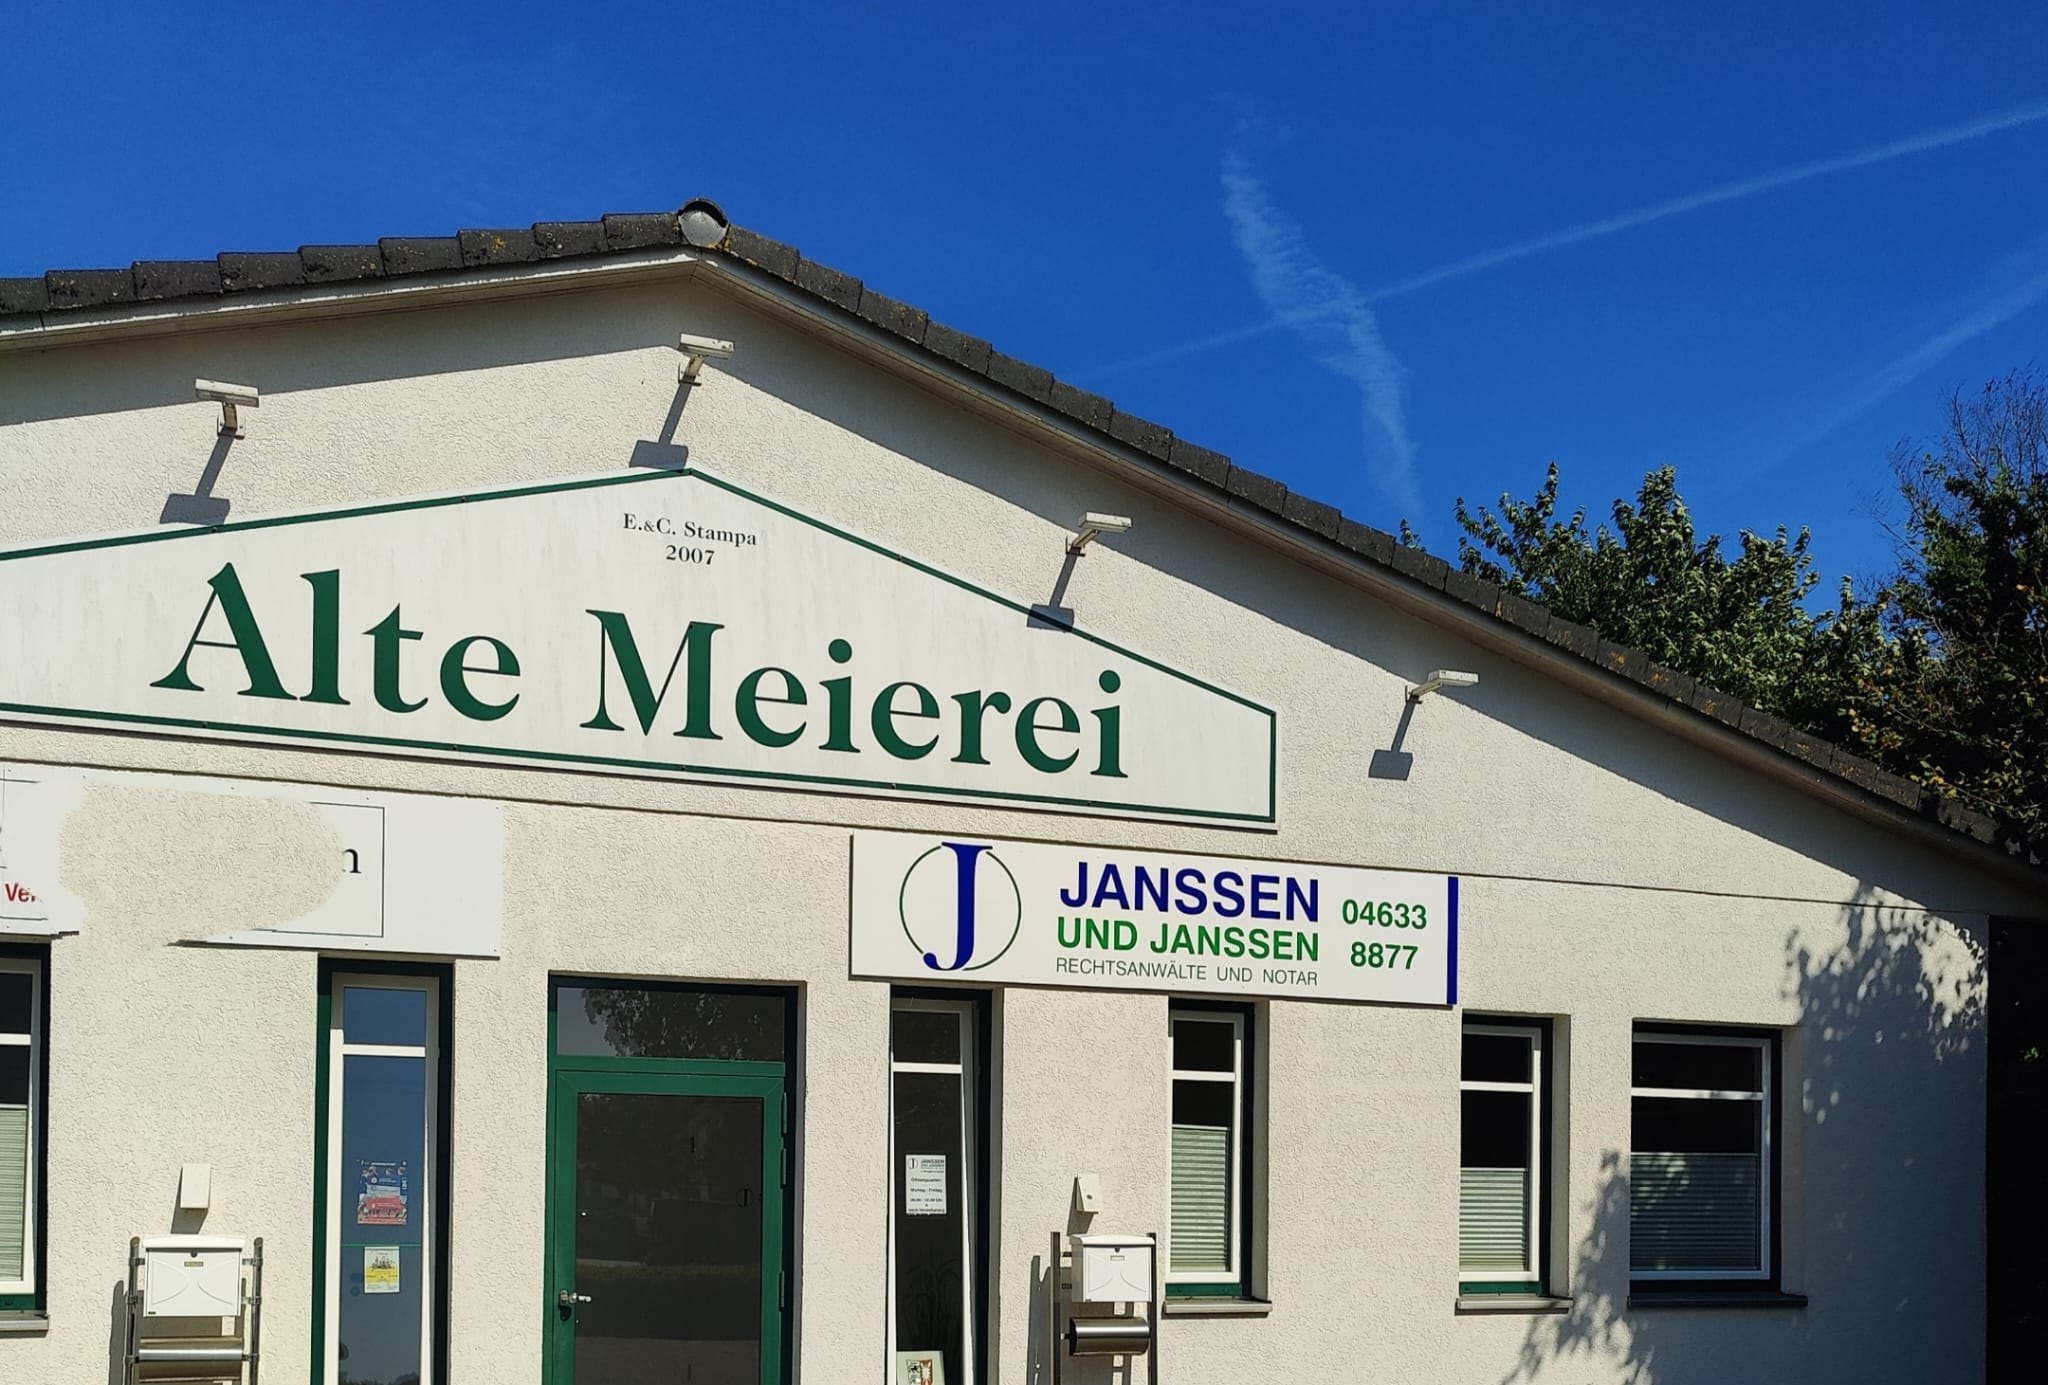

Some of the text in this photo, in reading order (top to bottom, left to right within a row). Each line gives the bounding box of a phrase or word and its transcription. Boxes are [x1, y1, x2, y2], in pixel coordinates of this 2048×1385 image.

[623, 512, 757, 547] E.&C. Stampa
[665, 544, 716, 566] 2007
[150, 562, 1129, 779] Alte Meierei
[1060, 861, 1319, 922] JANSSEN
[1342, 899, 1428, 930] 04633
[1057, 916, 1319, 961] UND JANSSEN
[1056, 956, 1318, 986] RECHTSANWÄLTE UND NOTAR
[1350, 942, 1419, 970] 8877
